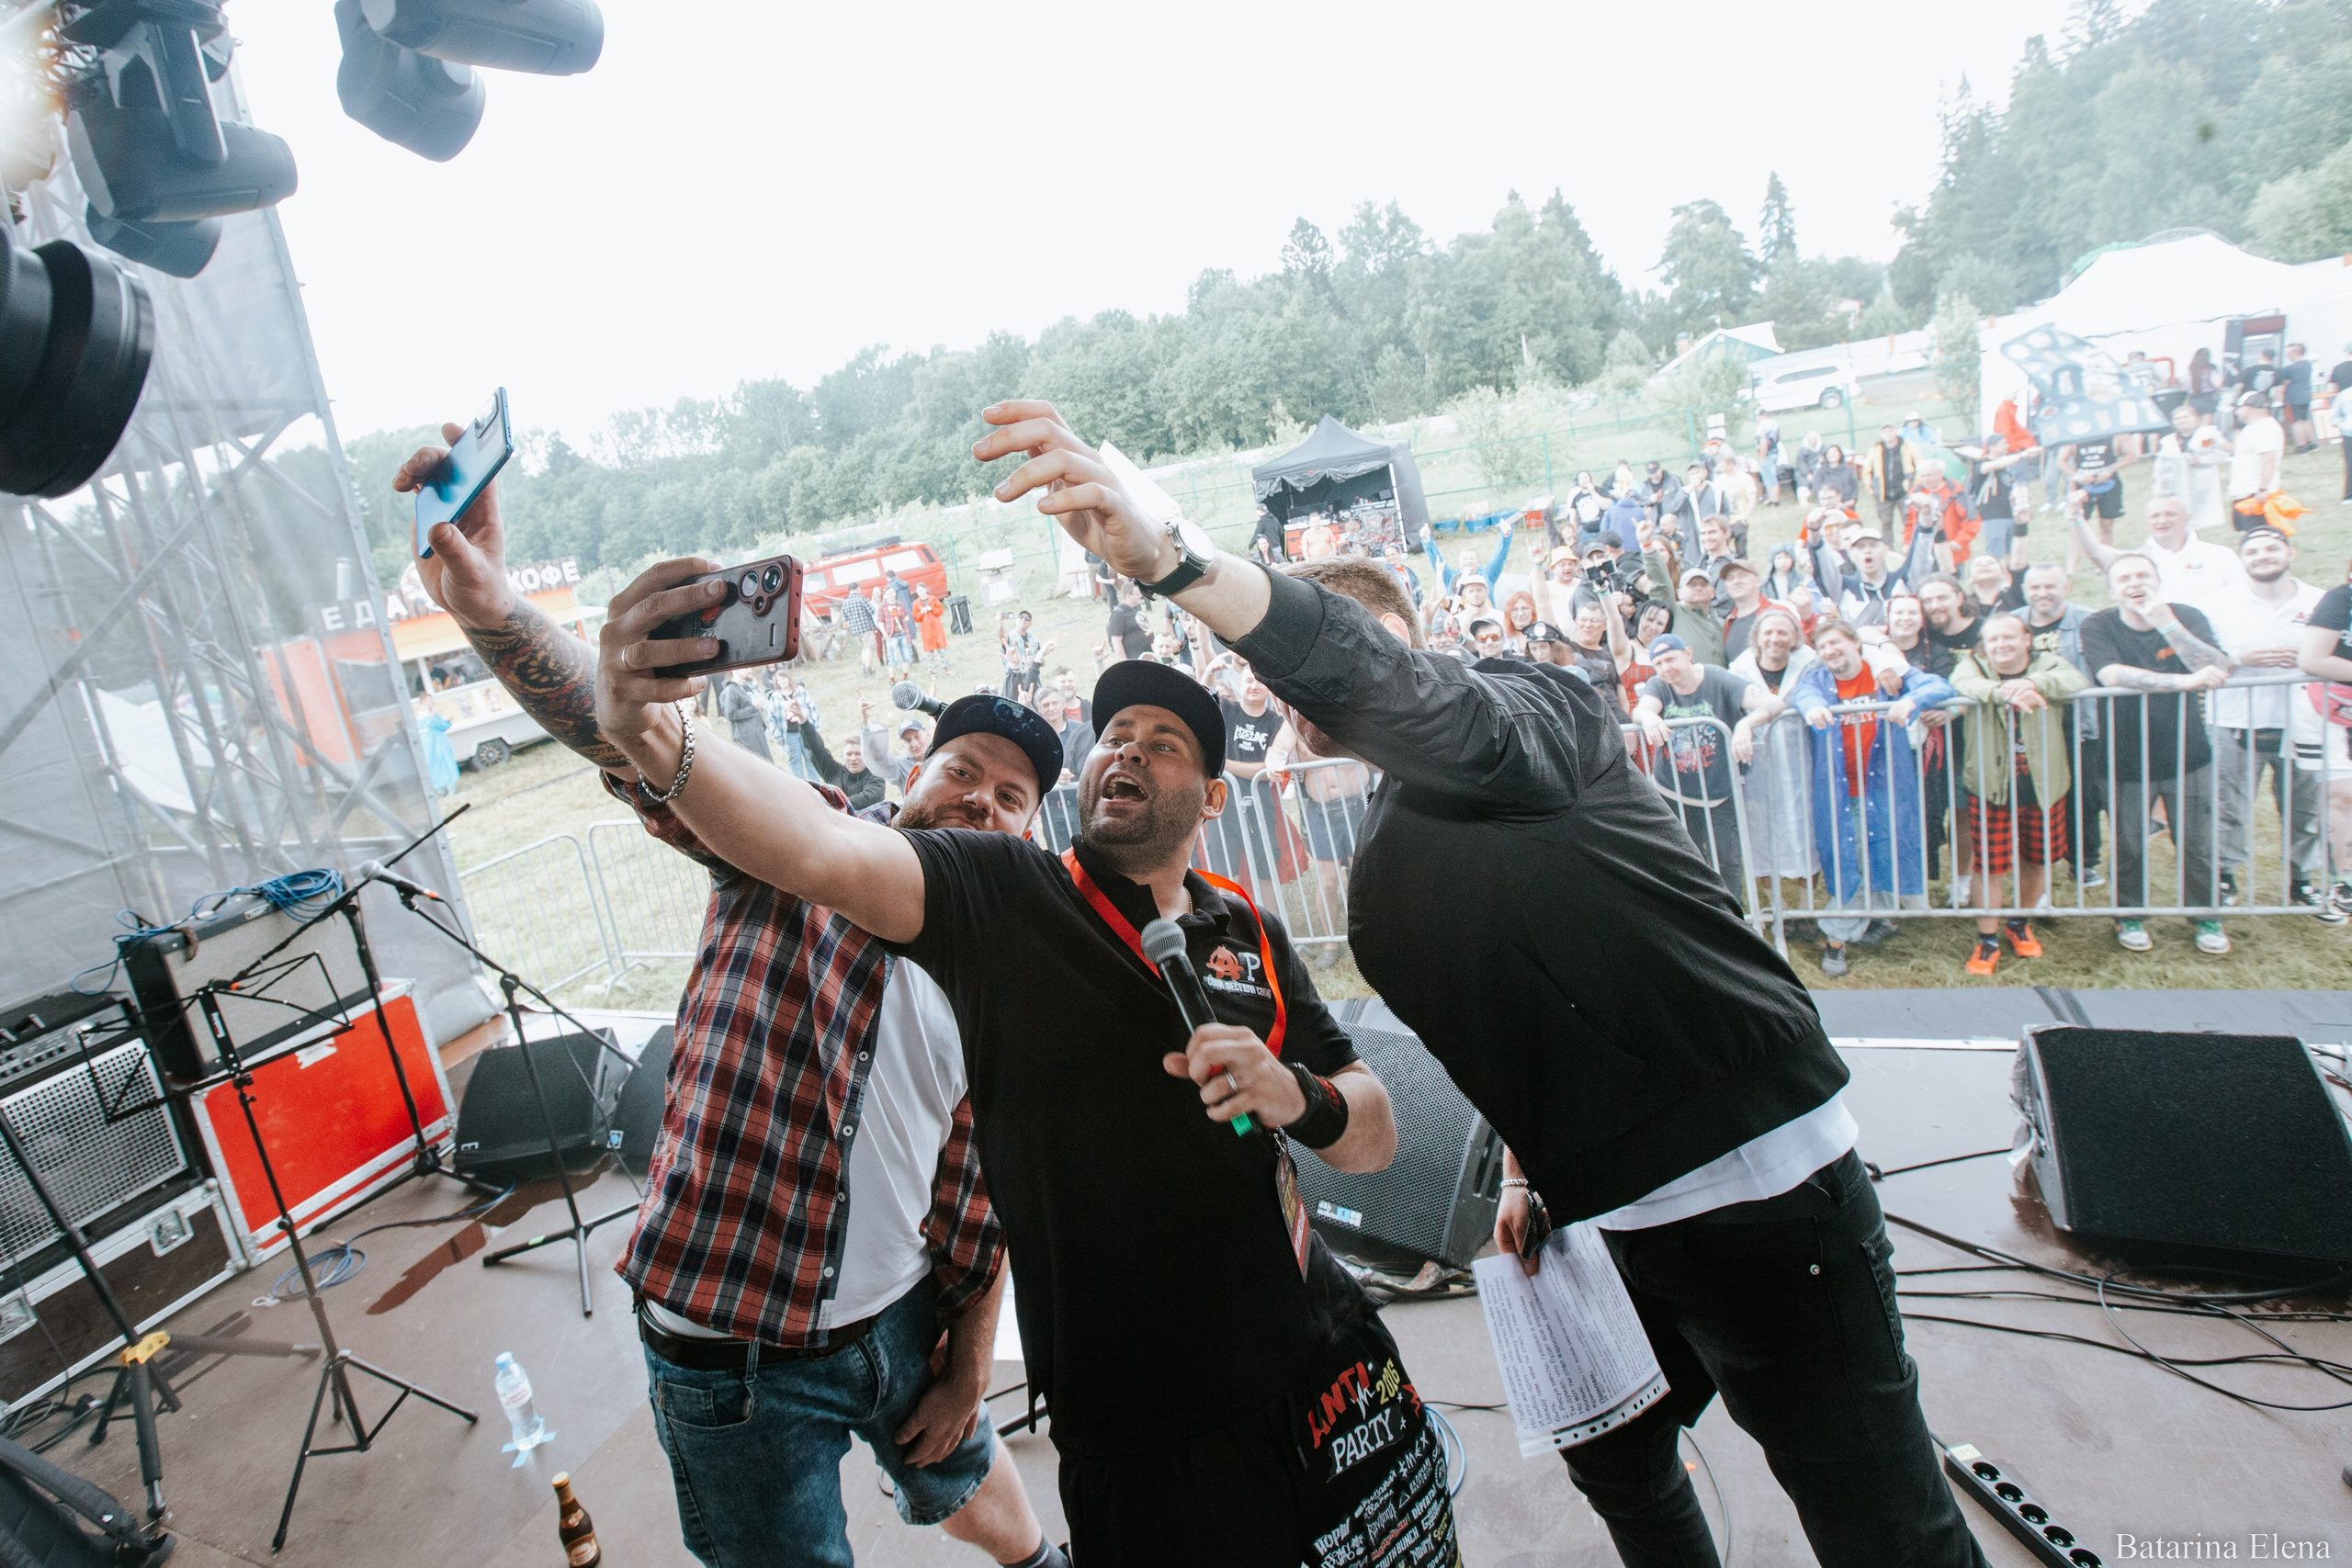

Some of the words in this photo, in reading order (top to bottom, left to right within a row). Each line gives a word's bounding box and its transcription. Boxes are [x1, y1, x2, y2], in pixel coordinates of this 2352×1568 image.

[322, 594, 408, 631] ЕДА
[504, 560, 581, 592] КОФЕ
[1493, 1305, 1505, 1327] будет
[1523, 1353, 1530, 1364] ты
[1543, 1342, 1557, 1364] будет
[1527, 1365, 1536, 1379] кем
[1553, 1363, 1561, 1377] что
[1559, 1359, 1569, 1376] стал
[1522, 1373, 1533, 1393] один
[1566, 1376, 1574, 1387] ты
[1520, 1391, 1528, 1402] же
[1552, 1386, 1566, 1411] Рисуя
[1570, 1388, 1580, 1402] вот
[1514, 1401, 1526, 1421] Тебе
[1524, 1403, 1532, 1416] кто
[1528, 1393, 1543, 1418] выбор
[1538, 1397, 1554, 1425] Между
[1567, 1404, 1577, 1416] Ты
[1575, 1402, 1585, 1415] Но
[1528, 1416, 1537, 1429] Но
[1332, 1408, 1394, 1474] PARTY
[1396, 1526, 1420, 1554] BUNCH
